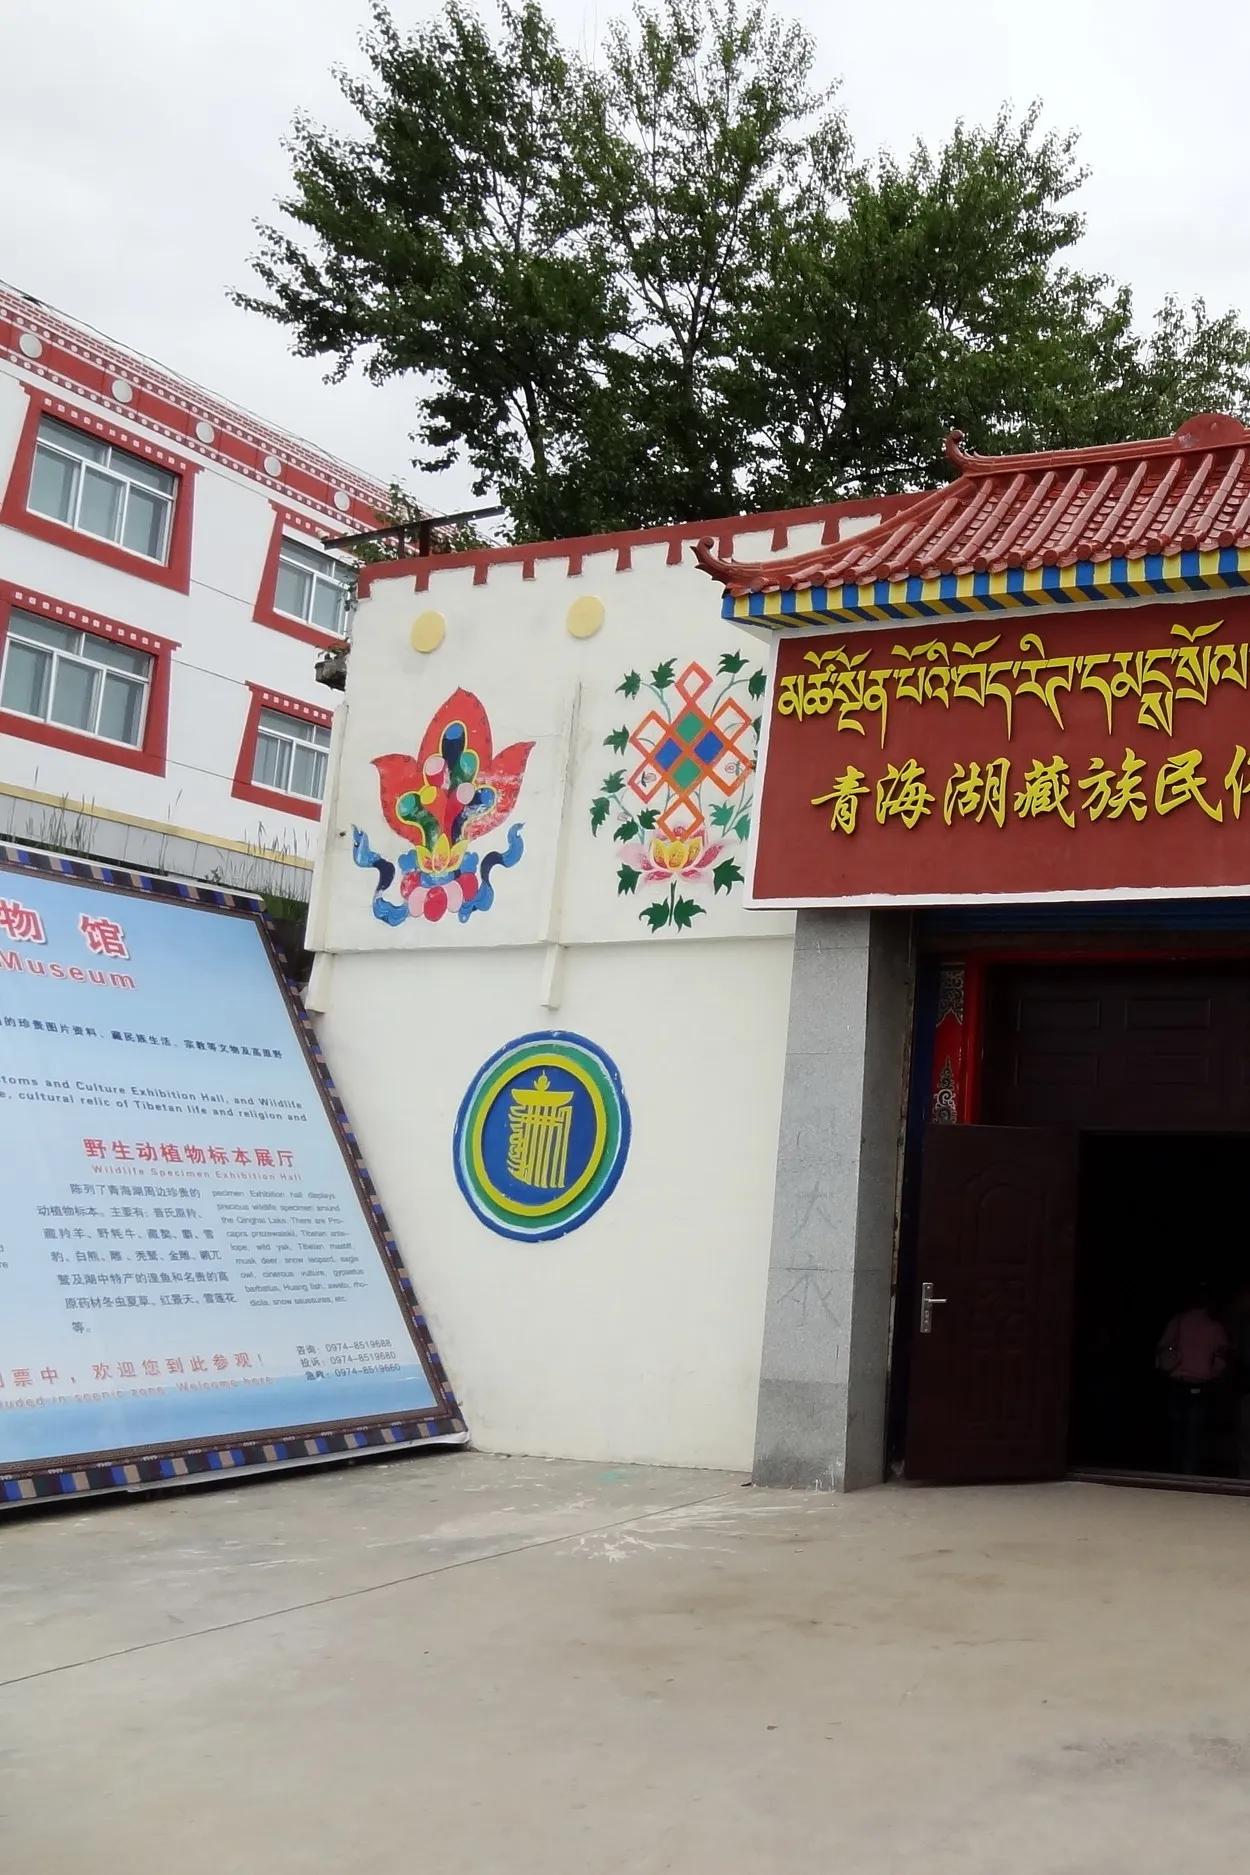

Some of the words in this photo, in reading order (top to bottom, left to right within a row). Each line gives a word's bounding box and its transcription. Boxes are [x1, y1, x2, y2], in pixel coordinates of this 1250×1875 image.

[0, 949, 136, 988] Museum
[0, 1075, 38, 1086] toms
[45, 1079, 70, 1089] and
[76, 1080, 125, 1094] Culture
[131, 1086, 196, 1100] Exhibition
[235, 1096, 254, 1106] and
[259, 1097, 302, 1109] Wildlife
[18, 1091, 74, 1103] cultural
[81, 1097, 110, 1107] relic
[116, 1099, 129, 1108] of
[133, 1100, 182, 1113] Tibetan
[188, 1104, 207, 1115] life
[213, 1107, 234, 1117] and
[239, 1107, 283, 1121] religion
[288, 1112, 307, 1122] and
[83, 1138, 294, 1168] 野生动植物标本展厅
[92, 1164, 144, 1175] Wildlife
[151, 1167, 210, 1178] Specimen
[215, 1170, 276, 1180] Exhibition
[280, 1173, 301, 1181] Hall
[0, 1351, 264, 1388] 票中，欢迎您到此参观！
[0, 1397, 45, 1410] uded
[176, 1380, 238, 1392] Welcome
[243, 1376, 273, 1385] here
